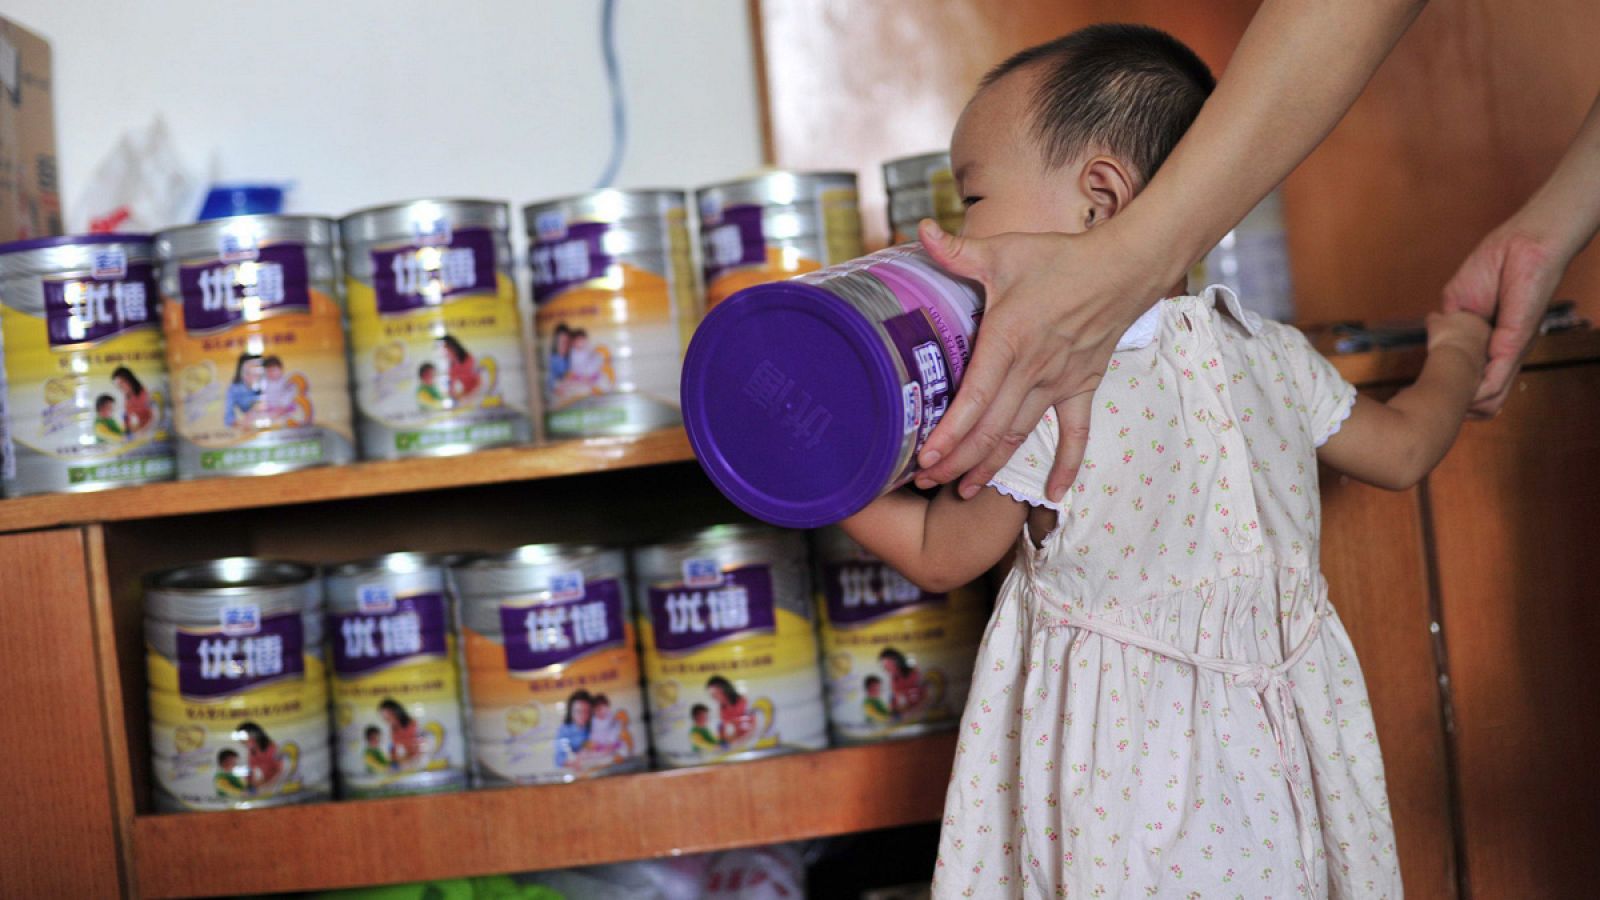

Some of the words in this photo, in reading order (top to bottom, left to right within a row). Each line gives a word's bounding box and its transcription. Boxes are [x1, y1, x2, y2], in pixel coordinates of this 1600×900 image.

[927, 305, 949, 334] BABY
[286, 372, 314, 429] 3
[478, 356, 502, 409] 2
[342, 611, 421, 657] 优博
[525, 601, 609, 653] 优博
[666, 587, 749, 634] 优博
[198, 635, 283, 679] 优博
[423, 720, 448, 771] 2
[752, 697, 778, 749] 2
[281, 742, 302, 794] 2
